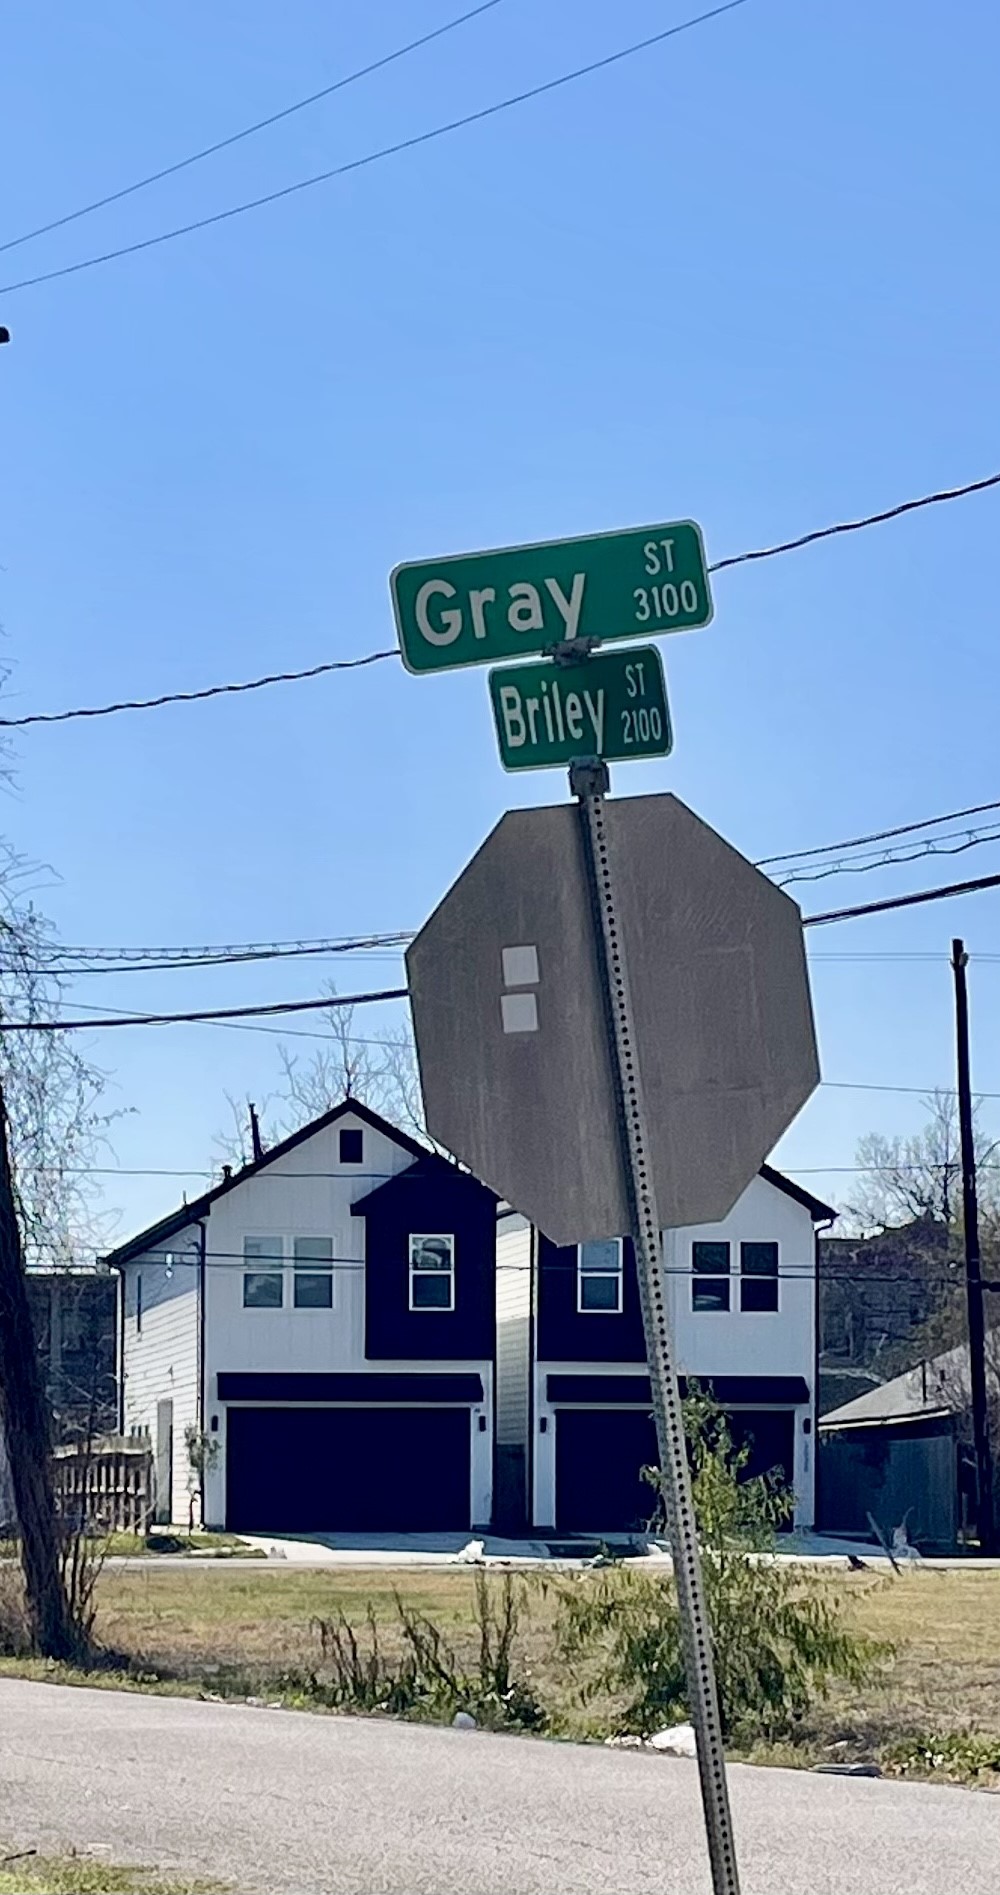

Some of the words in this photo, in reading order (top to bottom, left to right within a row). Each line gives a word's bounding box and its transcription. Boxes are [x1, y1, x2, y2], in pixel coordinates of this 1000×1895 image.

[643, 538, 675, 575] ST
[415, 573, 586, 647] Gray
[633, 580, 697, 621] 3100
[624, 663, 645, 698] ST
[500, 681, 604, 755] Briley
[621, 707, 662, 744] 2100
